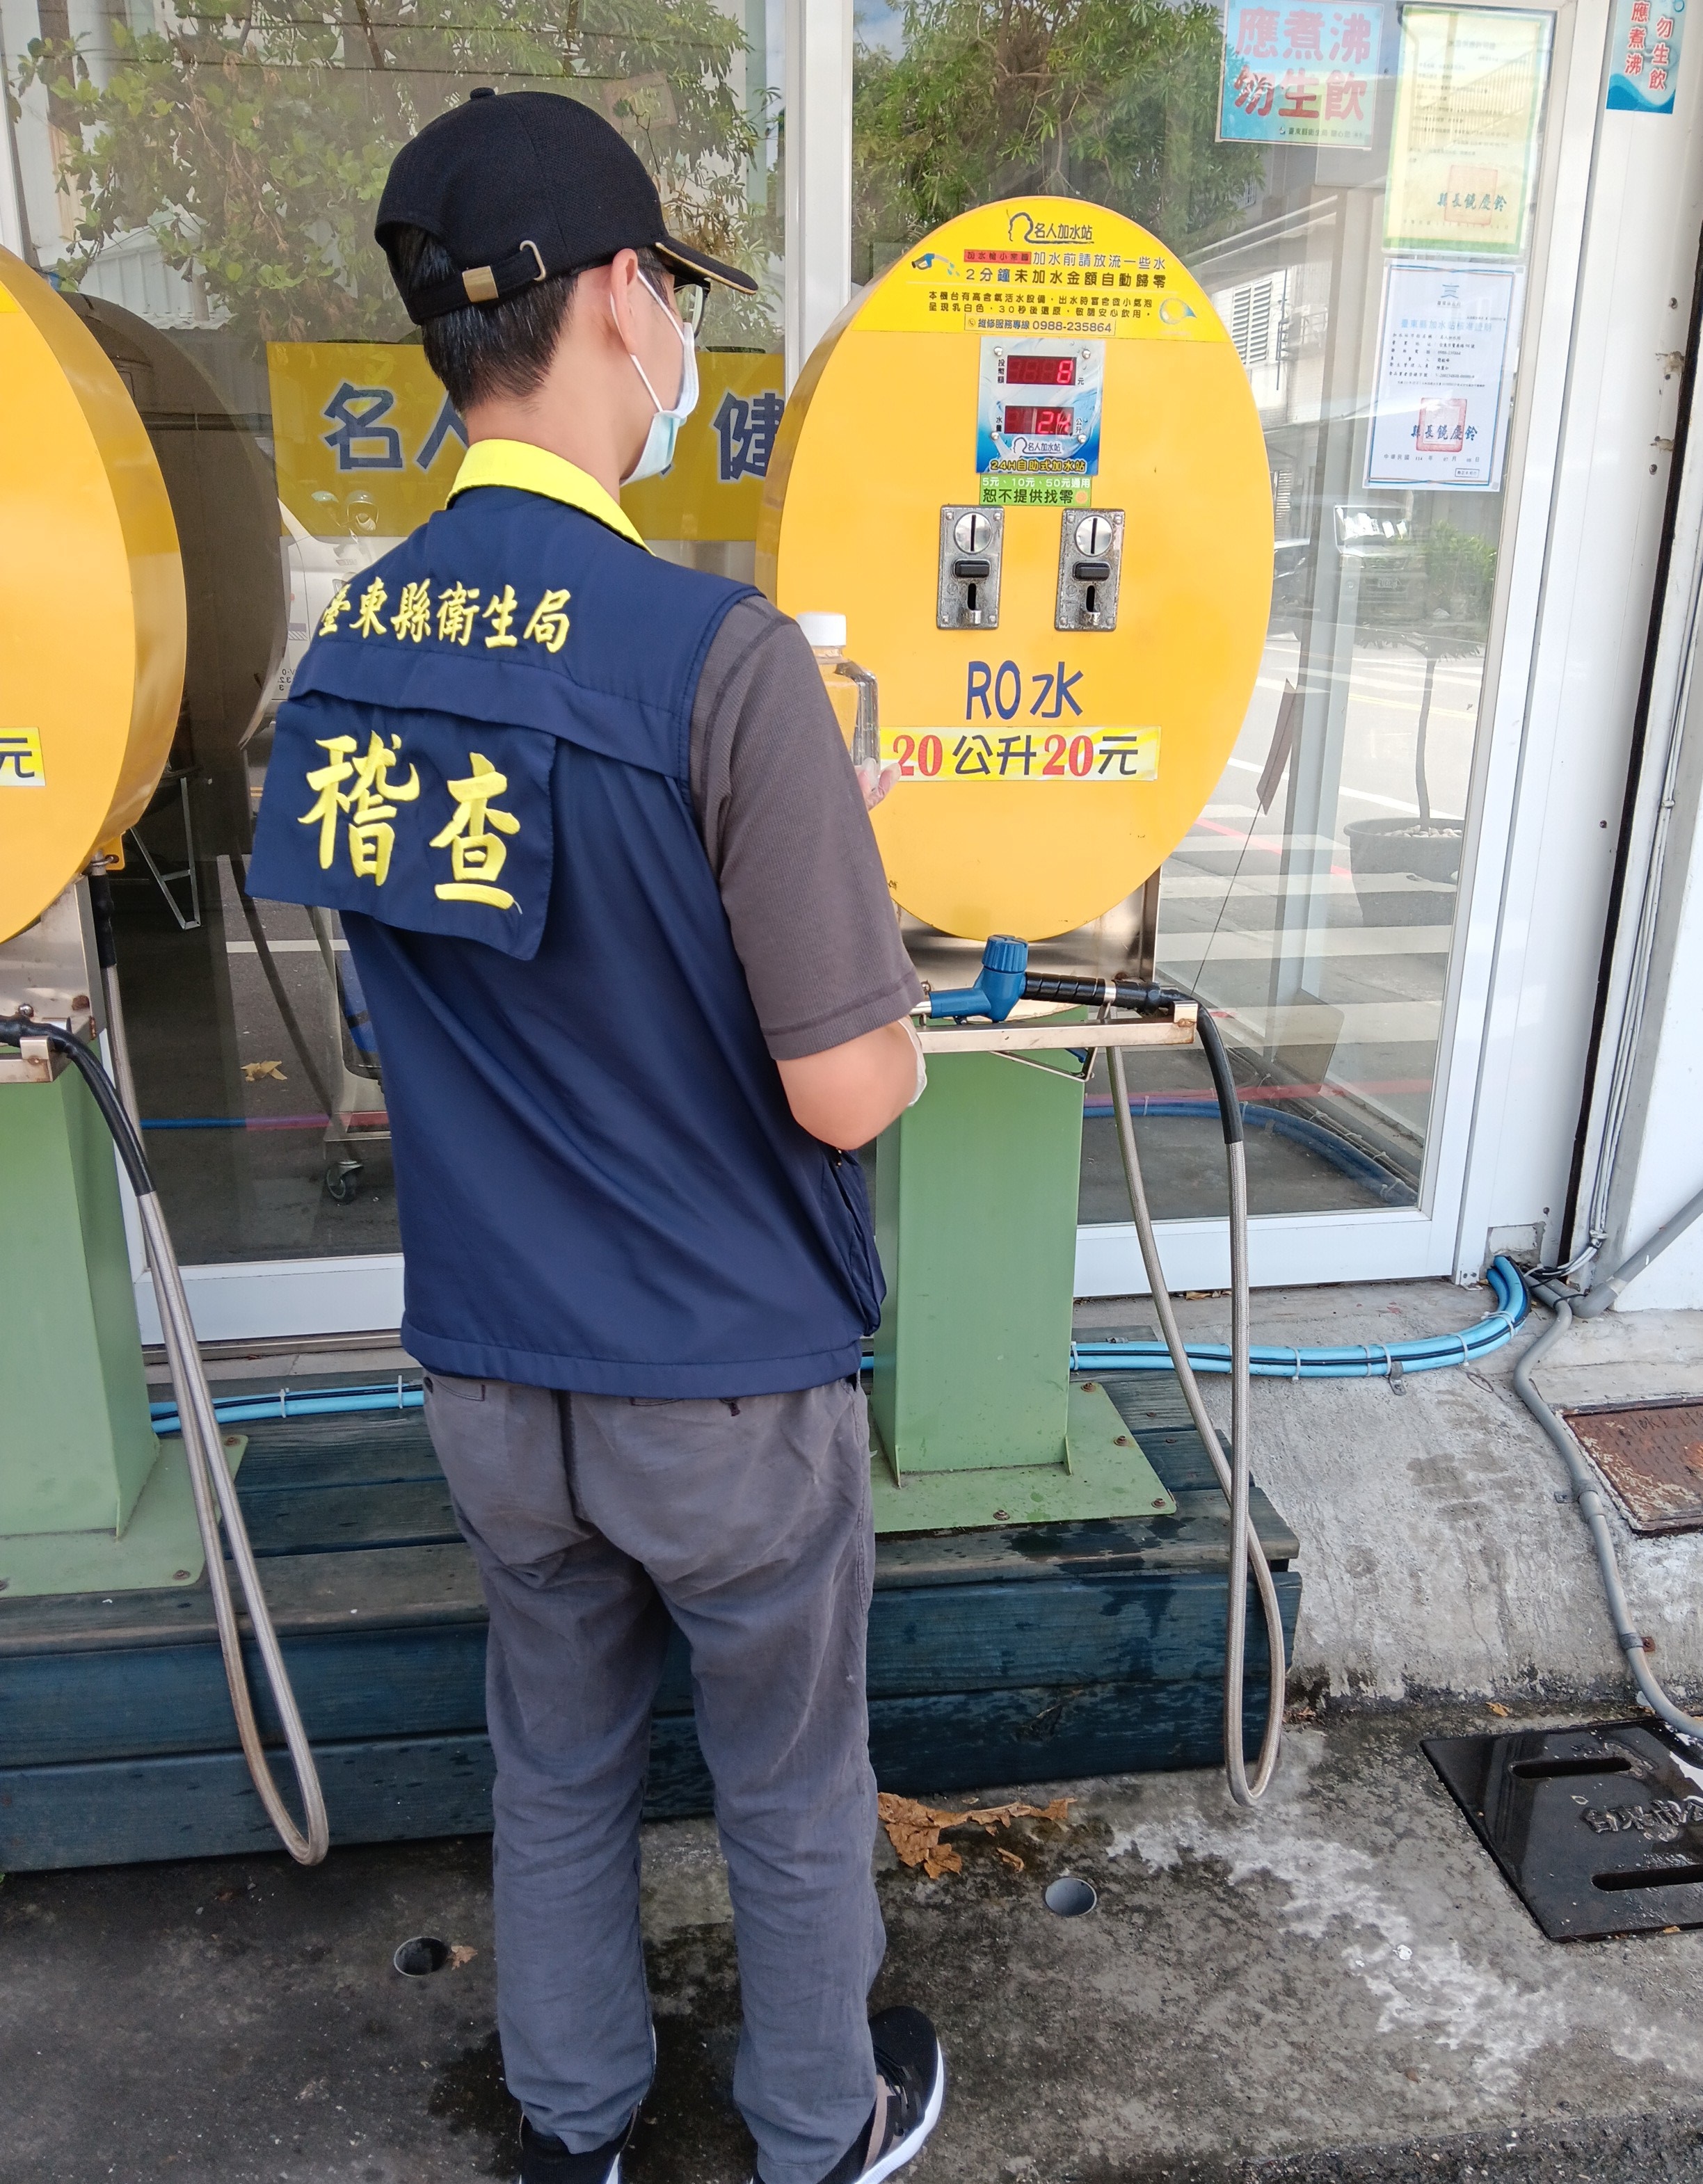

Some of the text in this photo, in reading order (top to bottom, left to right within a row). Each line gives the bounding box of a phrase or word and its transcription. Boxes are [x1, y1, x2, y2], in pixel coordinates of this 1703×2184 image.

[1236, 6, 1371, 65] 應煮沸
[1624, 1, 1650, 75] 應煮沸
[1649, 17, 1673, 90] 勿生飲
[1233, 64, 1368, 121] 勿生飲
[1034, 222, 1093, 241] 名人加水站
[1033, 252, 1166, 270] 加水前請放流一些水
[966, 268, 1167, 289] 2分鐘未加水金額自動歸零
[1032, 320, 1112, 333] 0988-235864
[1056, 360, 1073, 383] 8
[1077, 377, 1085, 385] 元
[1411, 424, 1478, 441] 縣長饒慶鈴
[1028, 442, 1062, 452] 名人加水站
[990, 458, 1086, 473] 24H自助式加水站
[982, 488, 1073, 504] 恕不提供找零
[319, 577, 570, 653] 臺東縣衛生局
[966, 660, 1084, 721] RO水
[0, 737, 35, 778] 元
[298, 730, 520, 910] 稽查
